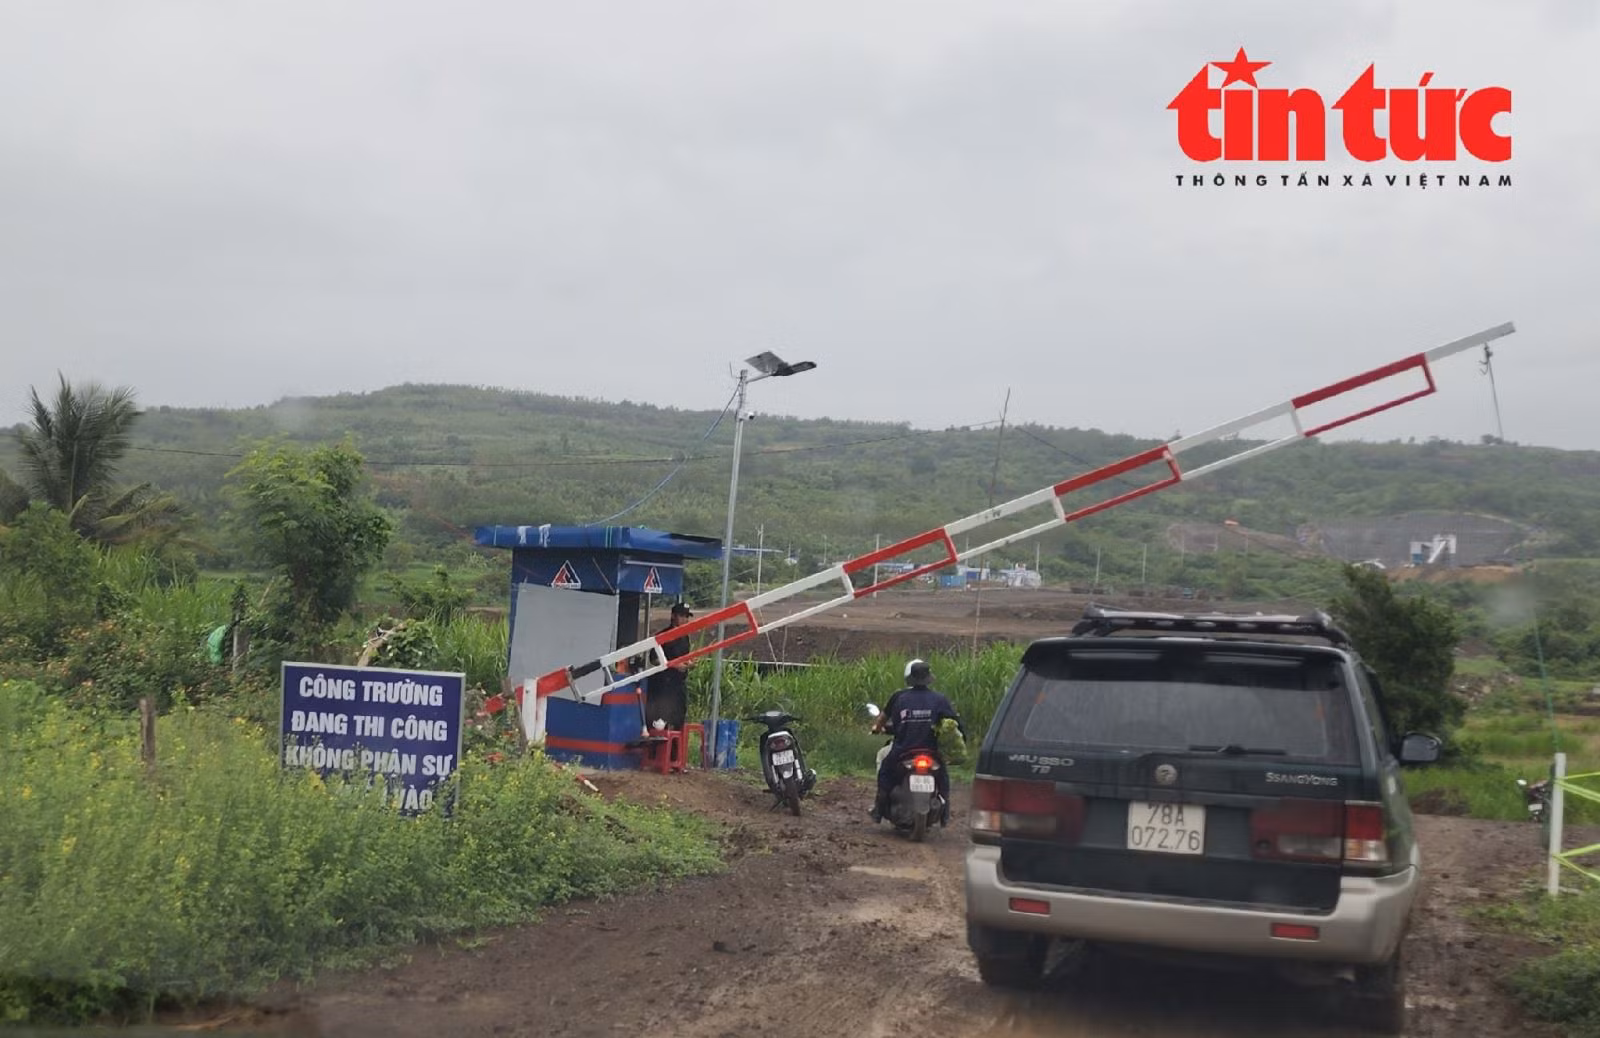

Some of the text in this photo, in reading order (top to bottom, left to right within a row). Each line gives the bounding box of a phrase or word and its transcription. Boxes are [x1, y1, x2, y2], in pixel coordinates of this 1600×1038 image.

[299, 673, 443, 706] CÔNG TRƯỜNG
[291, 710, 448, 741] ĐANG THI CÔNG
[285, 742, 354, 770] KHÔNG
[421, 754, 453, 781] SỰ
[1147, 803, 1184, 826] 78A
[1131, 825, 1201, 851] 072.76
